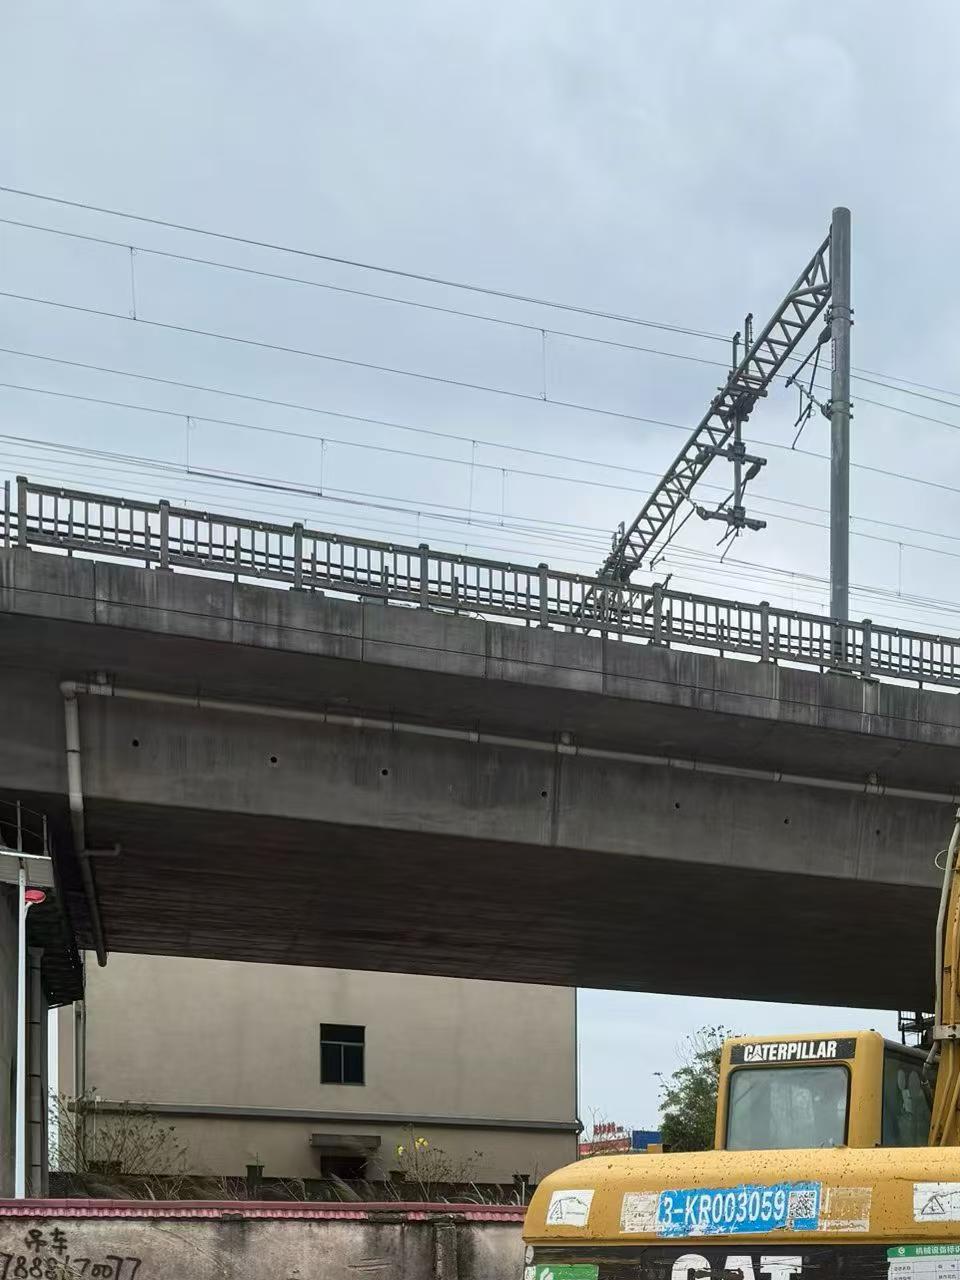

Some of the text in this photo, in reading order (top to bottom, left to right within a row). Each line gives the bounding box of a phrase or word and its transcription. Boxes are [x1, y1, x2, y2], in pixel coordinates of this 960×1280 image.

[743, 1040, 838, 1062] CATERPILLAR
[662, 1189, 787, 1226] 3-KR003059
[24, 1227, 68, 1255] 吊车
